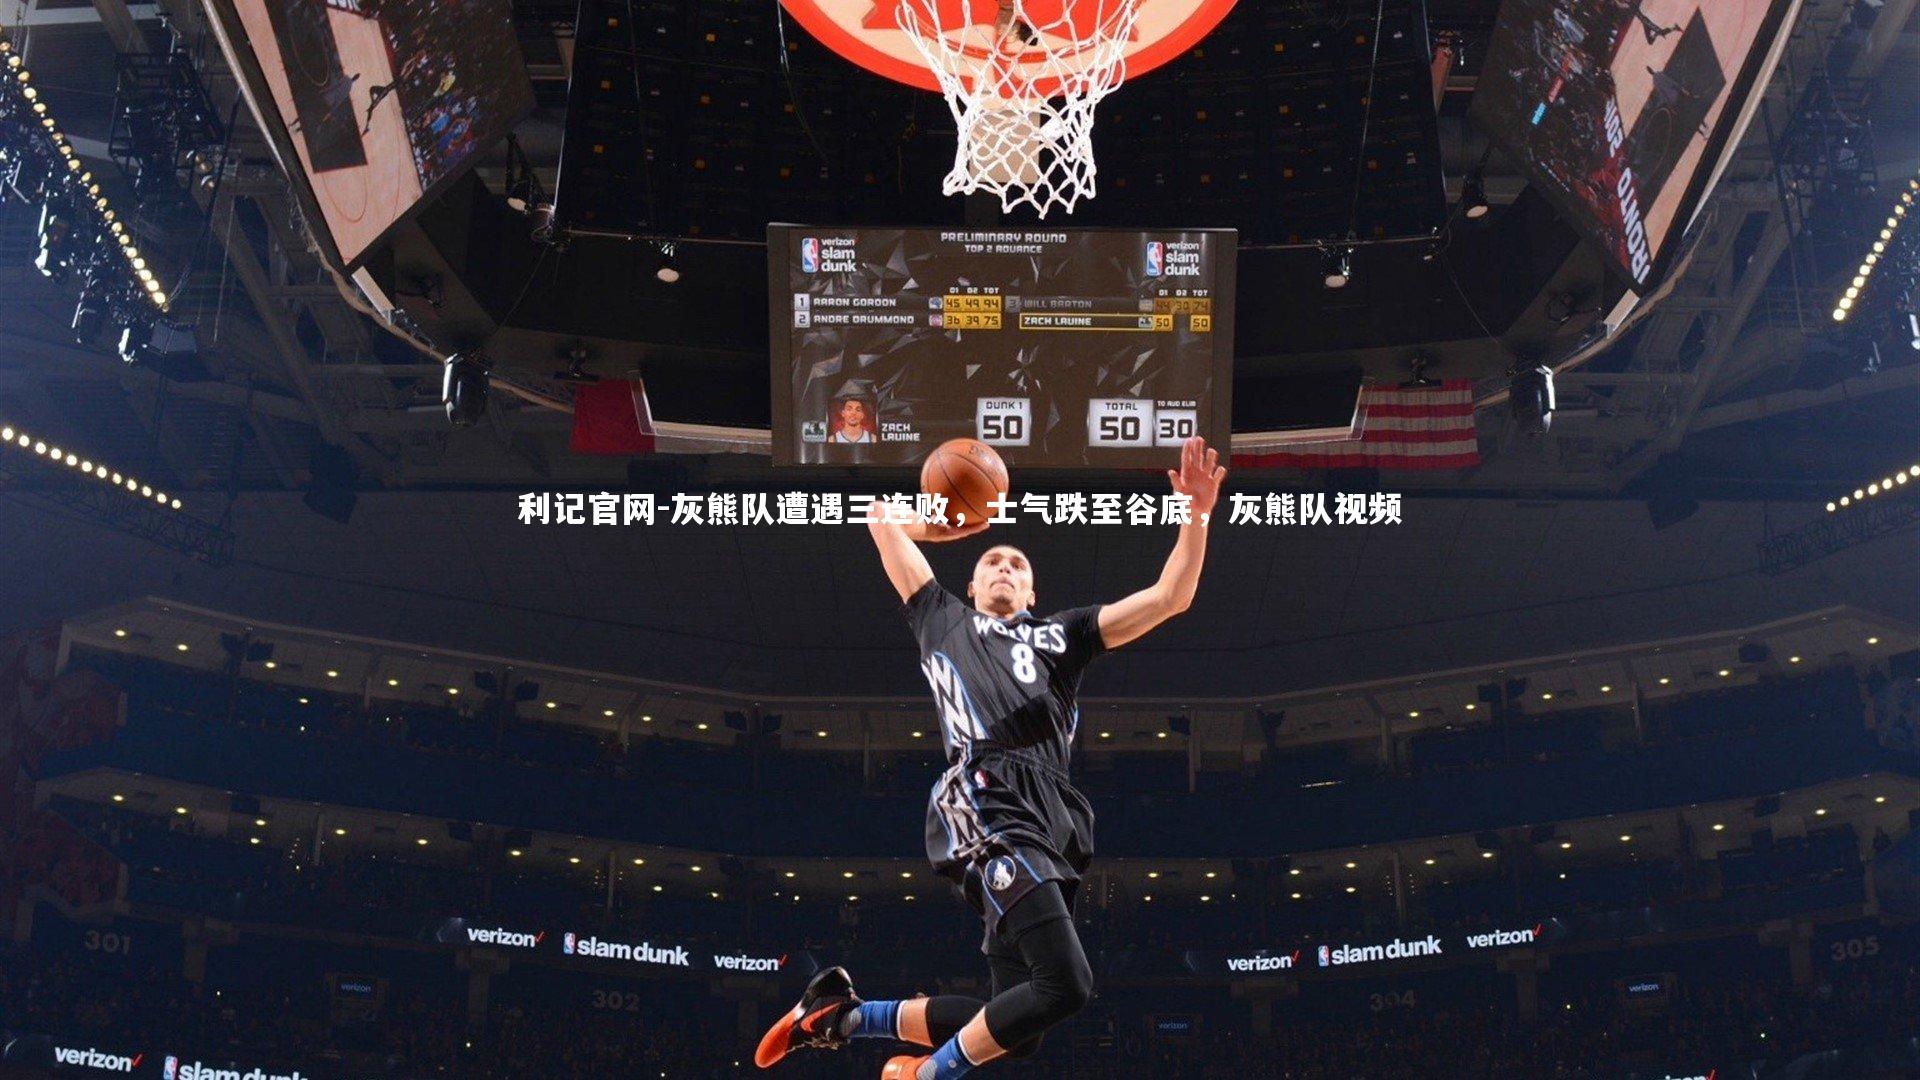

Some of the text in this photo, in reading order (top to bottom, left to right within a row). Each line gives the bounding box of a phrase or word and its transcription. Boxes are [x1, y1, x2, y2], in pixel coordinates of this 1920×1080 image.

[821, 237, 855, 246] verizon
[940, 232, 1067, 243] PRELIMINARY ROUND
[964, 245, 1042, 253] TOP 2 ADVANCE
[1165, 241, 1200, 250] verizon
[821, 246, 855, 259] slam
[1165, 250, 1200, 263] slam
[821, 260, 856, 272] dunk
[1164, 263, 1200, 276] dunk
[813, 298, 849, 307] AARON
[852, 298, 897, 307] GORDON
[946, 299, 960, 308] 45
[965, 299, 980, 308] 49
[984, 299, 999, 308] 94
[813, 315, 849, 324] ANDRE
[852, 315, 915, 325] DRUMMOND
[965, 315, 980, 325] 39
[983, 315, 999, 325] 75
[1024, 317, 1208, 328] ZACH LAVINE 50 50
[985, 401, 1014, 410] DUNK
[1105, 402, 1138, 411] TOTAL
[881, 423, 911, 432] ZACH
[983, 415, 1023, 440] 50
[1100, 416, 1140, 441] 50
[1159, 418, 1193, 438] 30
[881, 433, 920, 442] LAVINE
[973, 615, 1067, 654] WOLVES
[1010, 643, 1037, 684] 8
[467, 927, 536, 948] verizon
[1466, 929, 1533, 948] verizon
[576, 936, 690, 966] slam dunk
[1331, 935, 1443, 965] slam dunk
[714, 954, 778, 971] verizon
[1227, 955, 1292, 971] verizon
[54, 1046, 132, 1072] verizon
